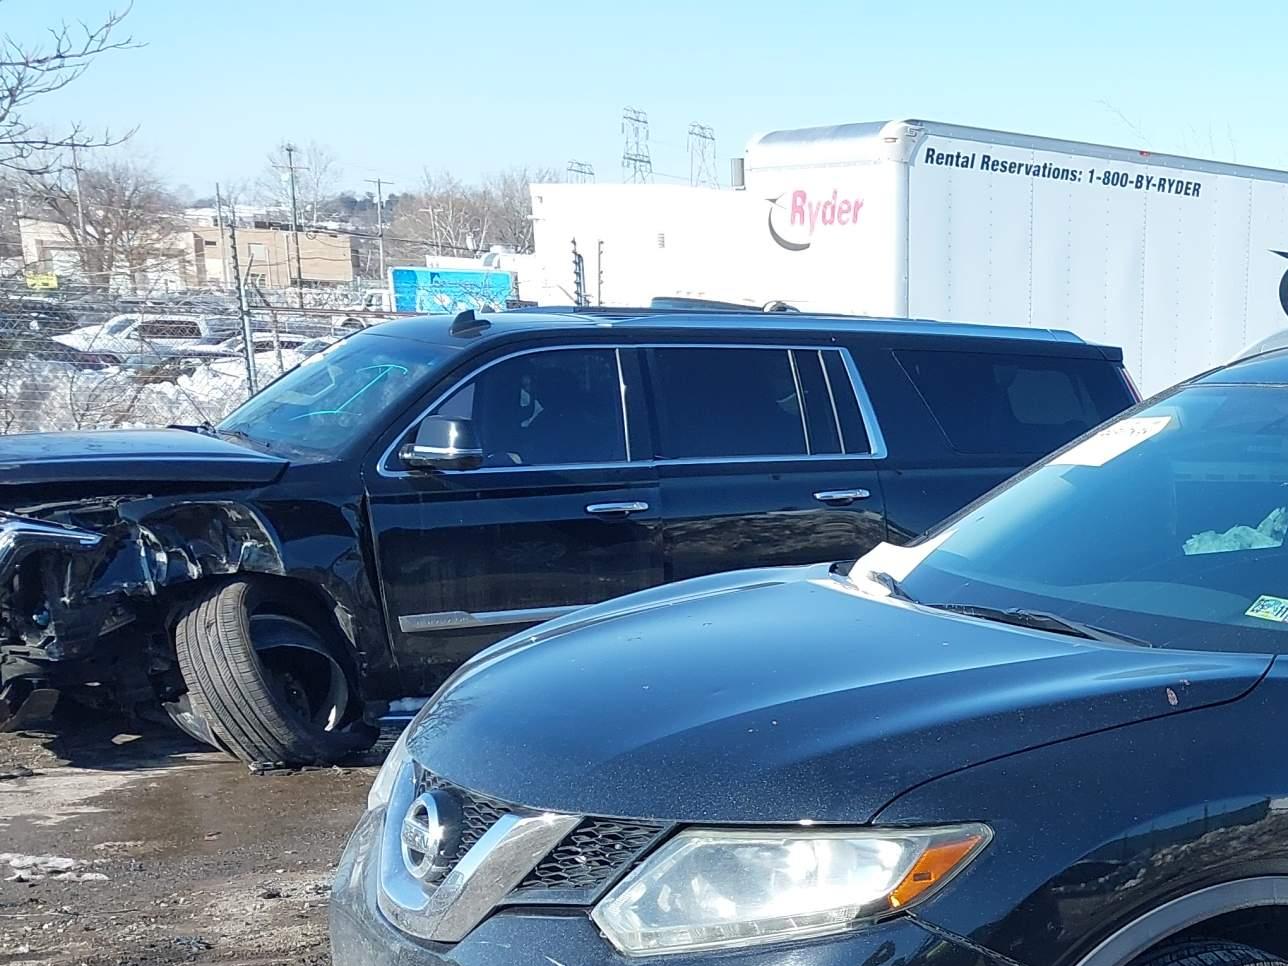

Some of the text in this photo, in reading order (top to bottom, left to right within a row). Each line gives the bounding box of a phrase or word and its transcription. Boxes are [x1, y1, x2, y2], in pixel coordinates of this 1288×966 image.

[925, 147, 1202, 197] Rental Reservations: 1-800-BY-RYDER
[790, 188, 864, 236] Ryder
